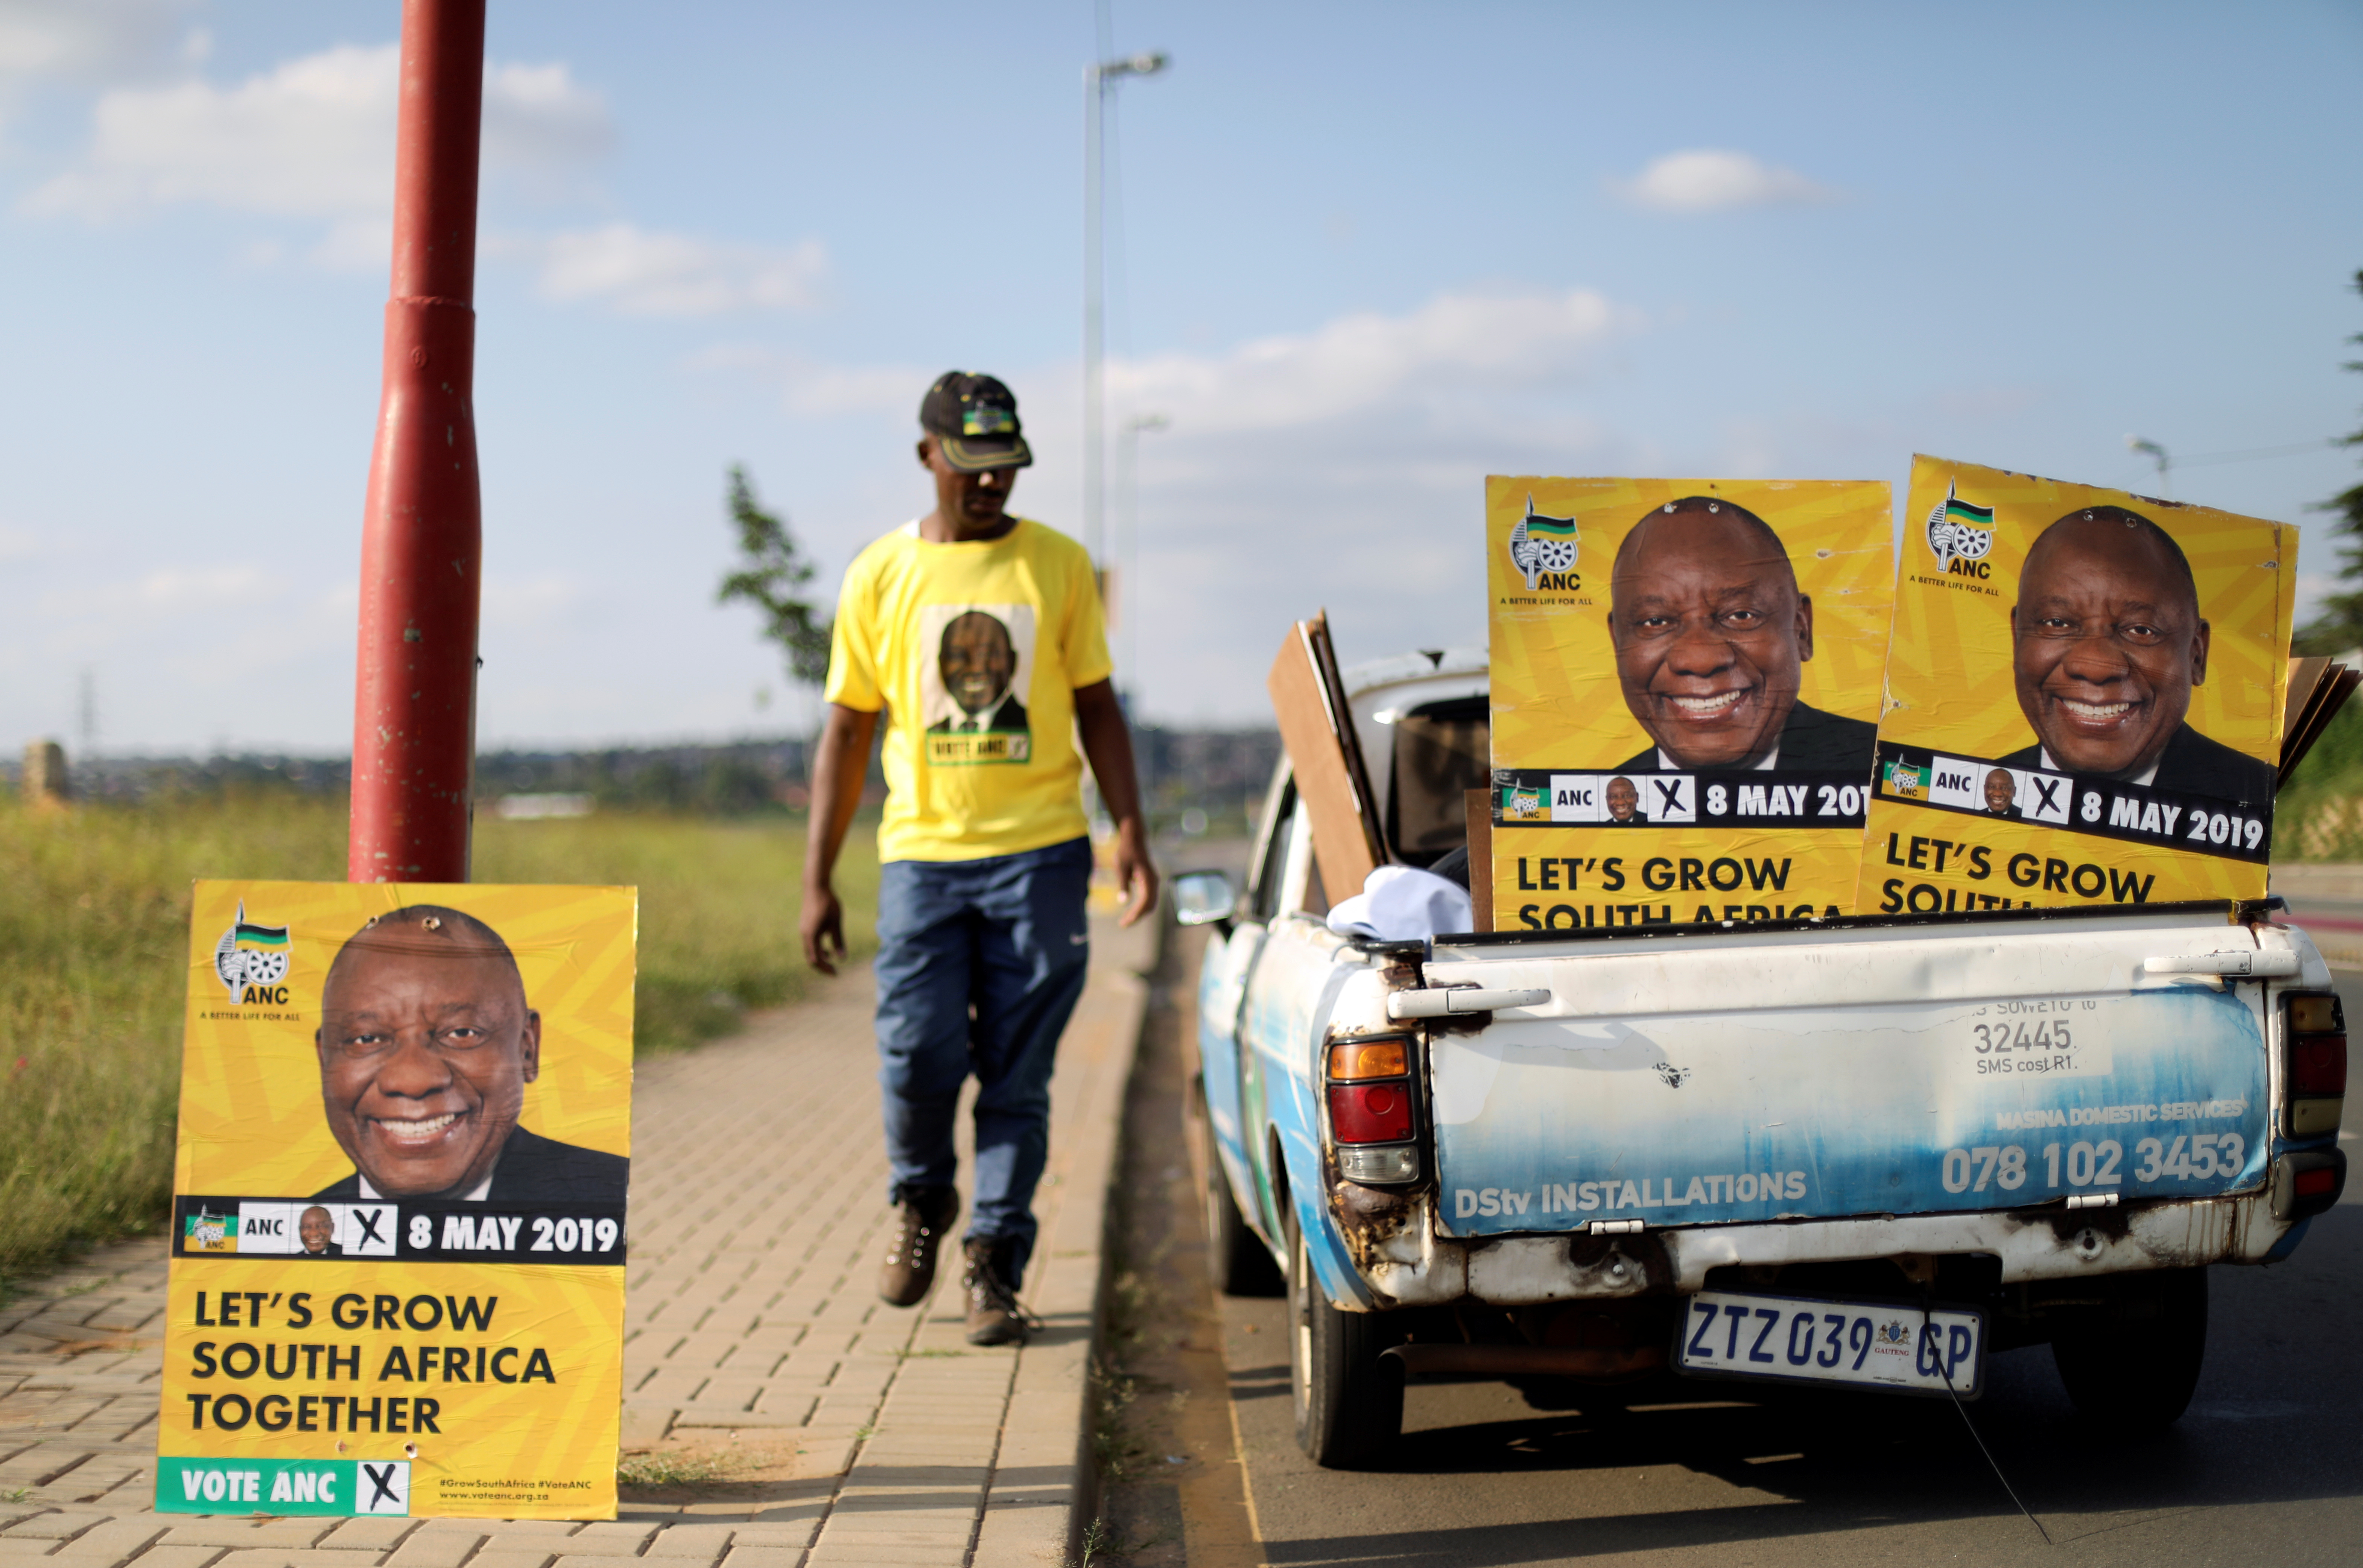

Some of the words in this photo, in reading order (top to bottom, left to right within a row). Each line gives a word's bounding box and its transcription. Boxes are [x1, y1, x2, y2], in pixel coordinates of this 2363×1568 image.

[1539, 574, 1580, 590] ANC
[1949, 558, 1990, 579] ANC
[1919, 576, 1945, 587] BETTER
[1966, 585, 1982, 593] FOR
[1900, 787, 1917, 797] ANC
[1936, 772, 1971, 792] ANC
[1557, 790, 1592, 806] ANC
[1707, 785, 1727, 815] 8
[1737, 785, 1808, 815] MAY
[1818, 785, 1870, 816] 201
[2081, 792, 2102, 822] 8
[2109, 796, 2182, 835] MAY
[2187, 810, 2263, 849] 2019
[1642, 857, 1792, 891] GROW
[2007, 853, 2156, 903] GROW
[243, 987, 288, 1004] ANC
[210, 1011, 239, 1020] BETTER
[243, 1012, 259, 1020] LIFE
[1974, 1020, 2077, 1054] 32445.
[1977, 1059, 2012, 1074] SMS
[2017, 1057, 2048, 1072] cost
[2054, 1055, 2077, 1069] R1.
[1997, 1109, 2067, 1130] MASINA
[2070, 1104, 2158, 1126] DOMESTIC
[2160, 1100, 2243, 1121] SERVICES
[1942, 1145, 2026, 1193] 078
[2043, 1140, 2122, 1188] 102
[2134, 1133, 2244, 1182] 3453
[1455, 1188, 1532, 1218] DStv
[1542, 1171, 1806, 1213] INSTALLATIONS
[245, 1219, 283, 1236] ANC
[408, 1215, 432, 1249] 8
[441, 1215, 524, 1250] MAY
[530, 1217, 618, 1252] 2019
[331, 1293, 498, 1331] GROW
[191, 1341, 360, 1380] SOUTH
[378, 1346, 557, 1383] AFRICA
[1916, 1323, 1972, 1379] GP
[187, 1394, 442, 1434] TOGETHER
[181, 1471, 260, 1502] VOTE
[269, 1471, 336, 1503] ANC
[439, 1492, 549, 1502] www.voteanc.org.za
[440, 1479, 535, 1489] #GrowSouthAfrica
[538, 1481, 592, 1489] #VoteANC
